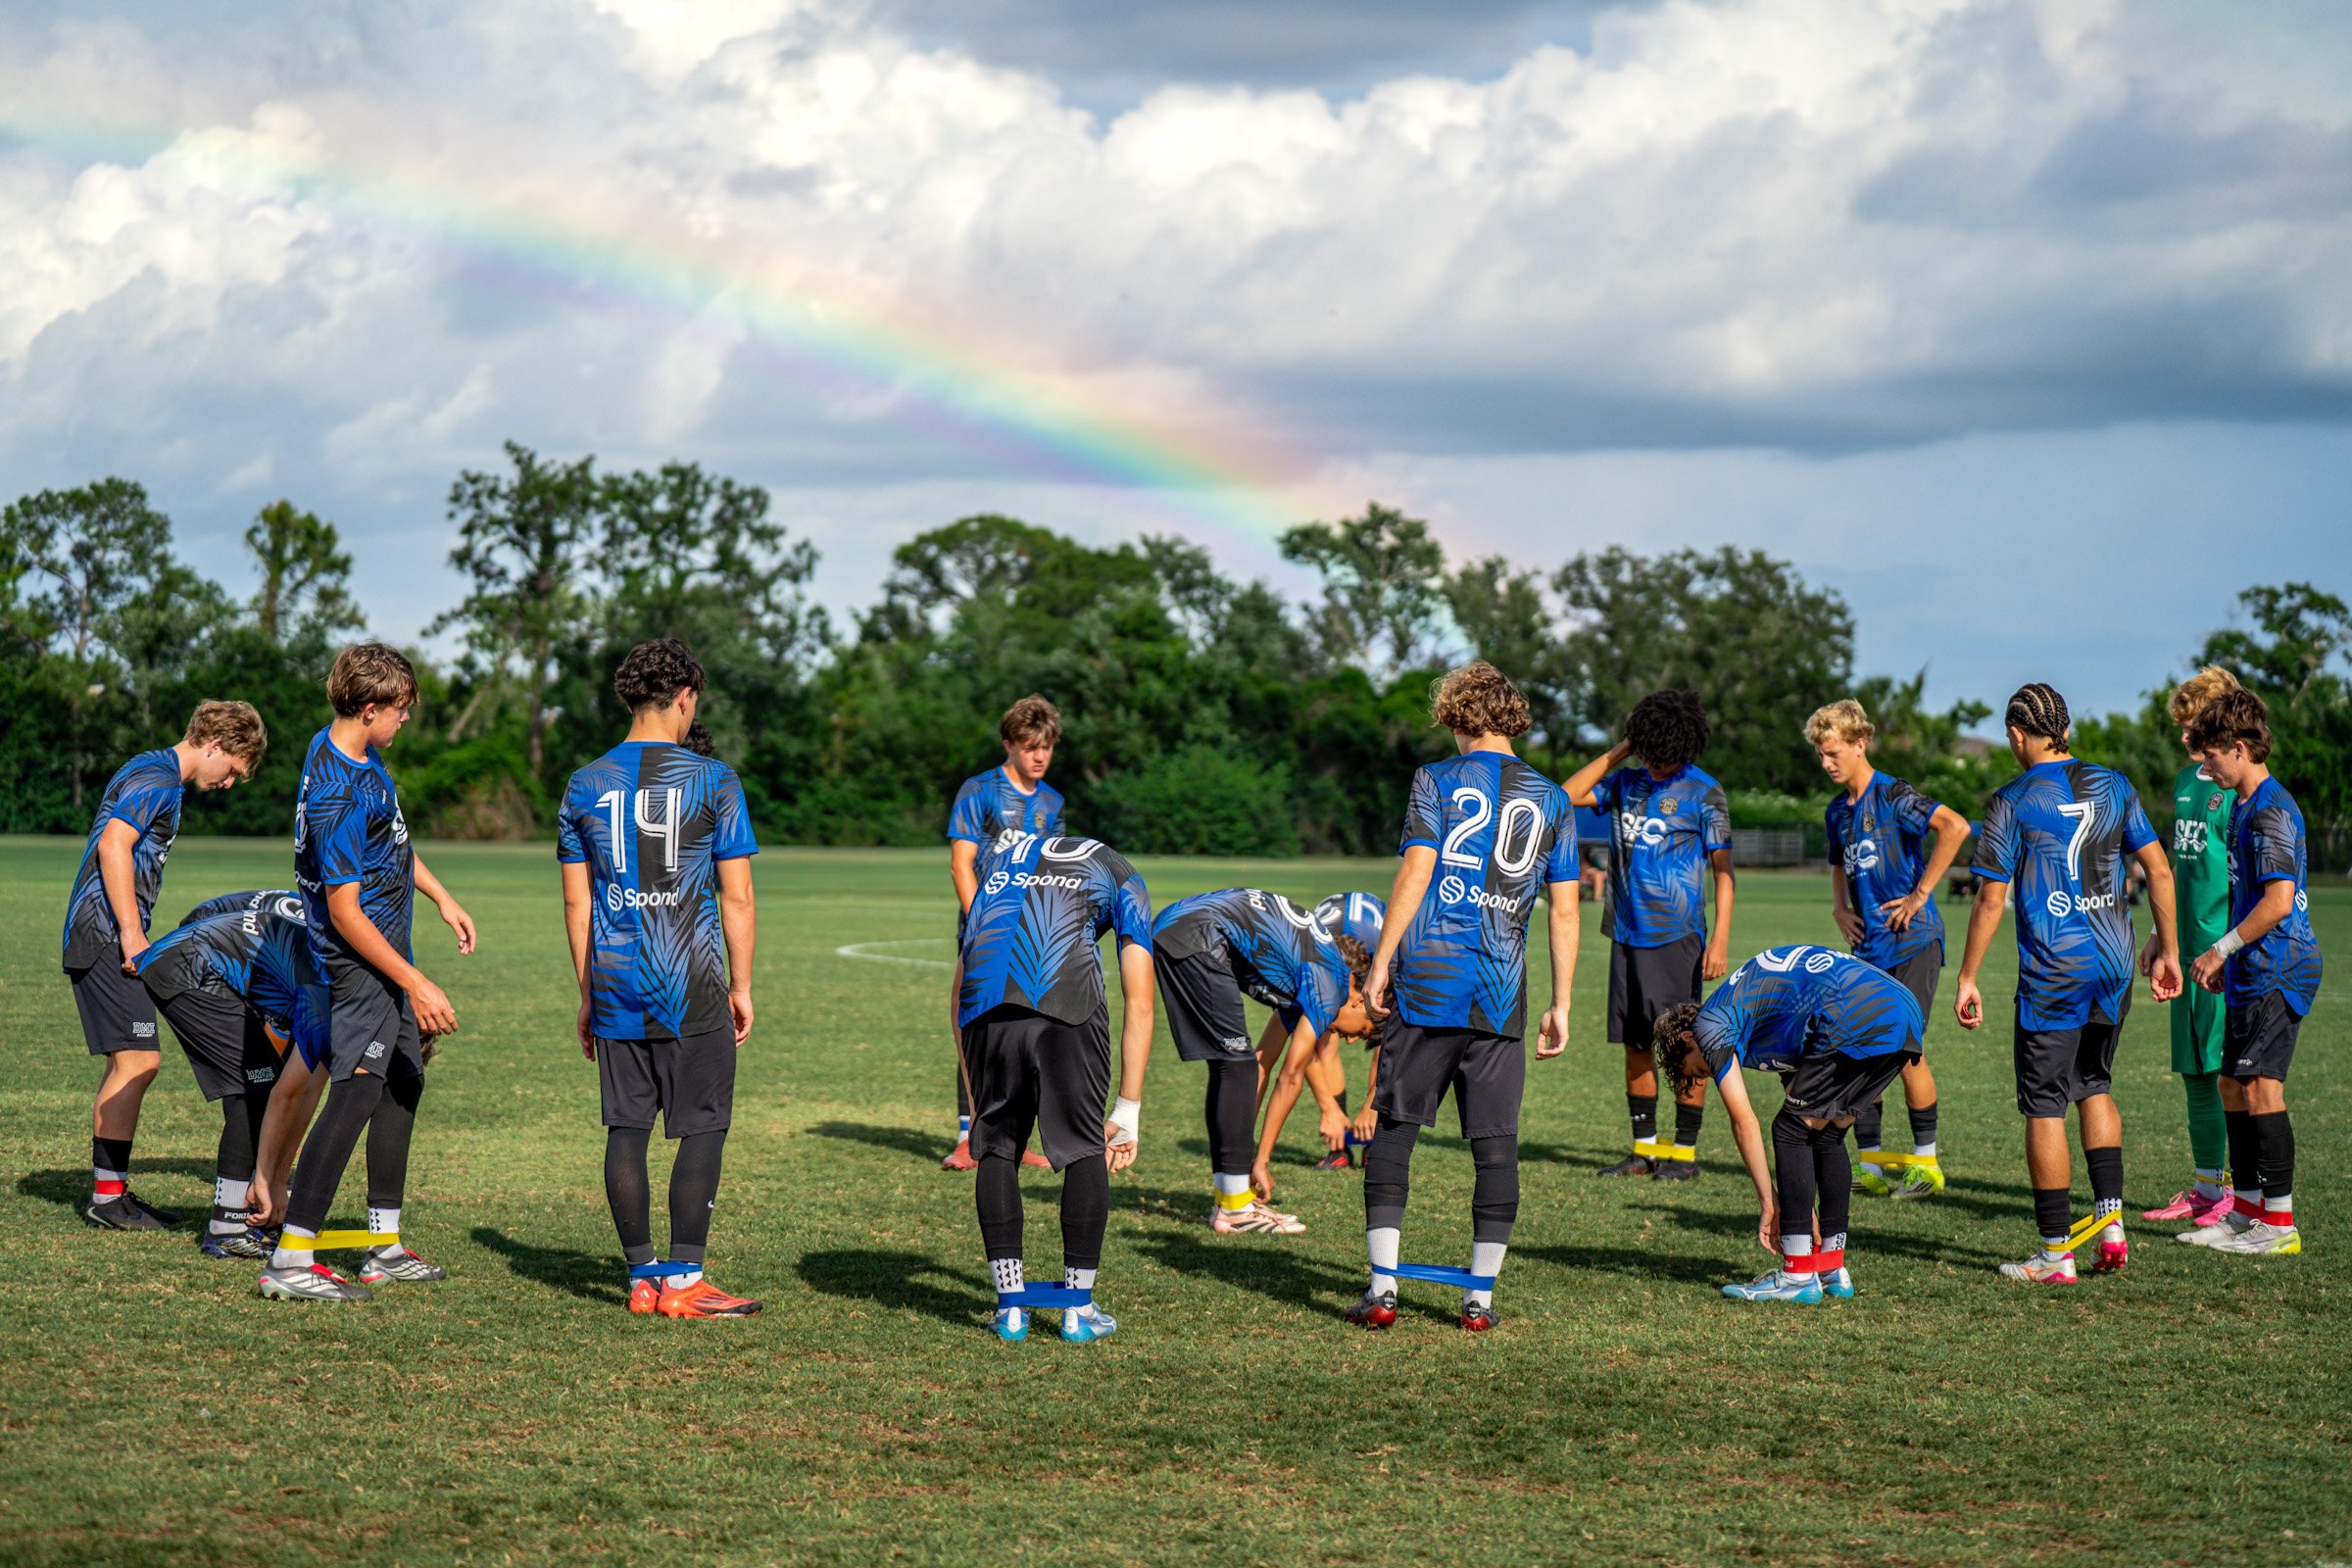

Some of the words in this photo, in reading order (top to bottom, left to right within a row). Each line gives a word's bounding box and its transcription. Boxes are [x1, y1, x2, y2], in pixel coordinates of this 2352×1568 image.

[595, 787, 682, 874] 14
[1442, 787, 1545, 878] 20
[1621, 812, 1667, 845] SFC
[2057, 801, 2095, 881] 7
[2174, 818, 2208, 853] SFC
[1843, 839, 1879, 876] SFC
[1011, 871, 1083, 890] Spond
[624, 887, 680, 910] Spond
[1466, 885, 1521, 913] Spond
[132, 1021, 156, 1033] DME
[367, 1041, 385, 1057] ME
